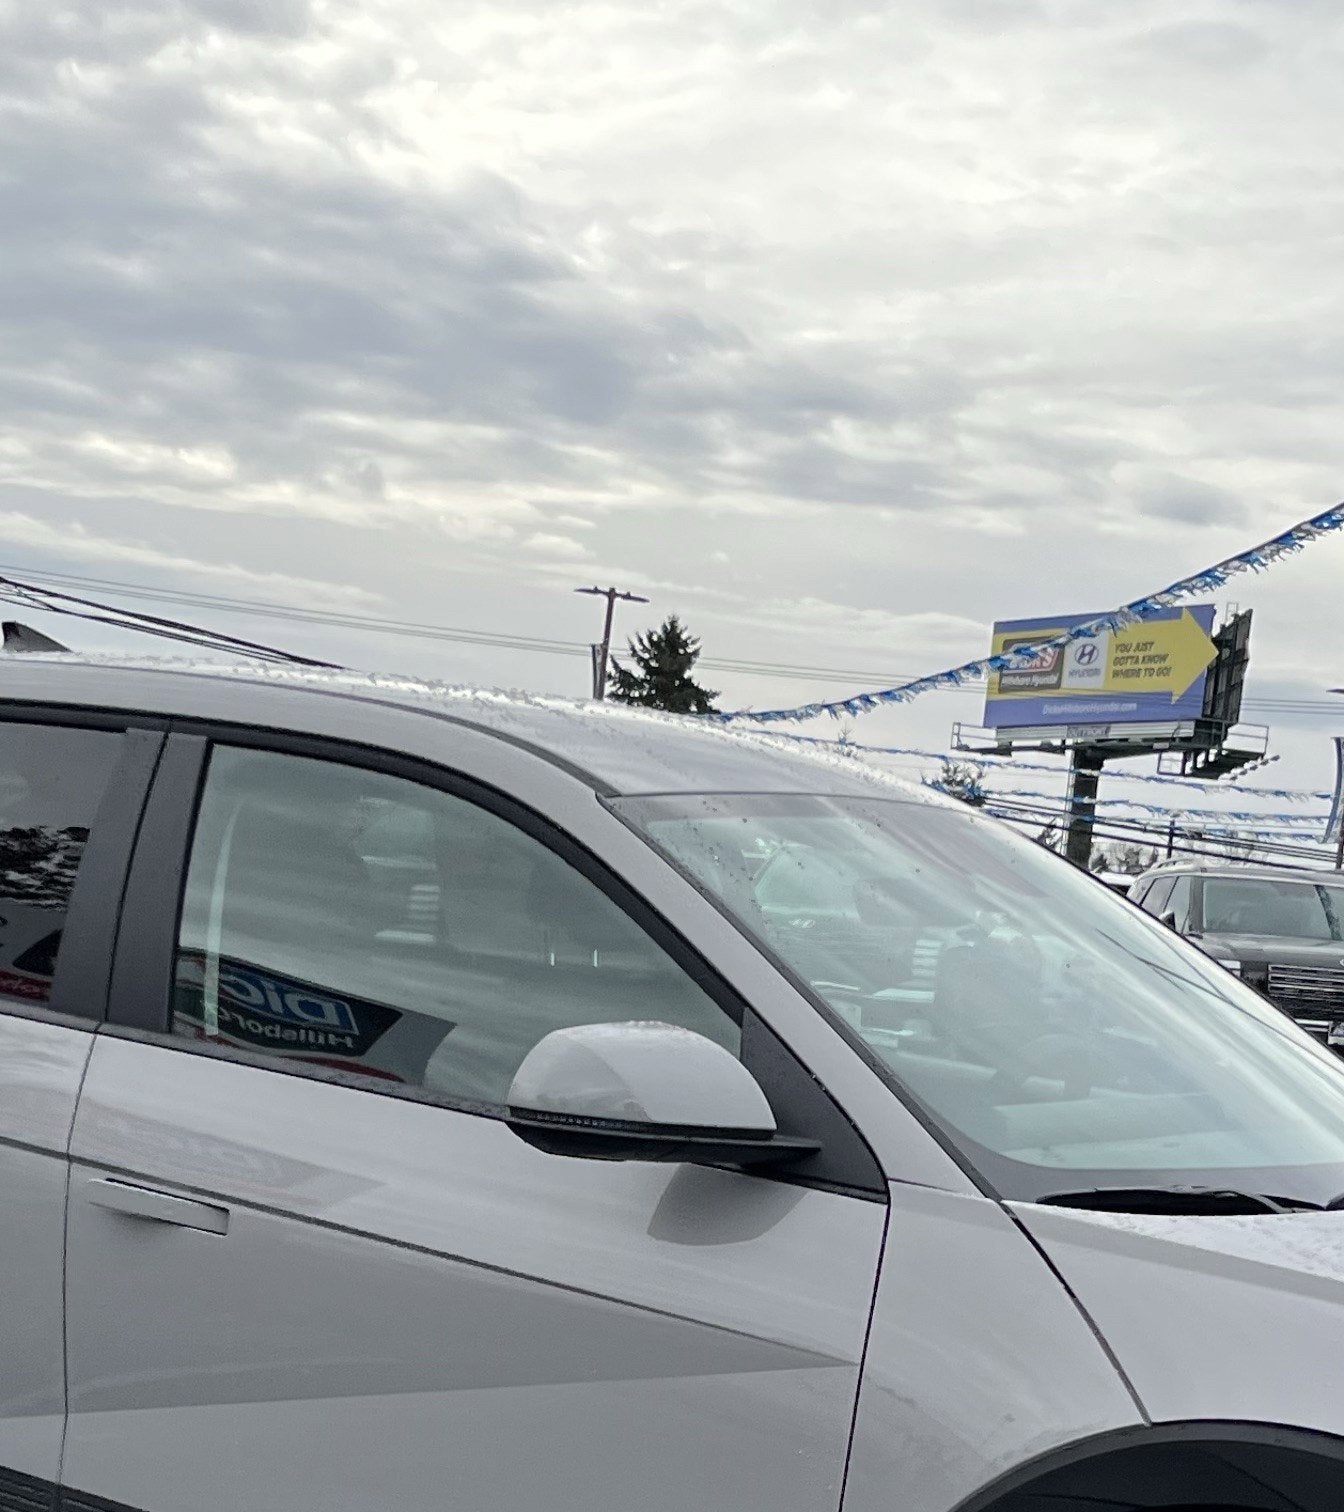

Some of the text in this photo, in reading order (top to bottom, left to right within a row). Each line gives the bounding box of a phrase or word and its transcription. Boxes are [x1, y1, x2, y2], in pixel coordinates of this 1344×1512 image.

[1114, 641, 1155, 654] YOU JUST
[1112, 653, 1169, 667] GOTTA KNOW
